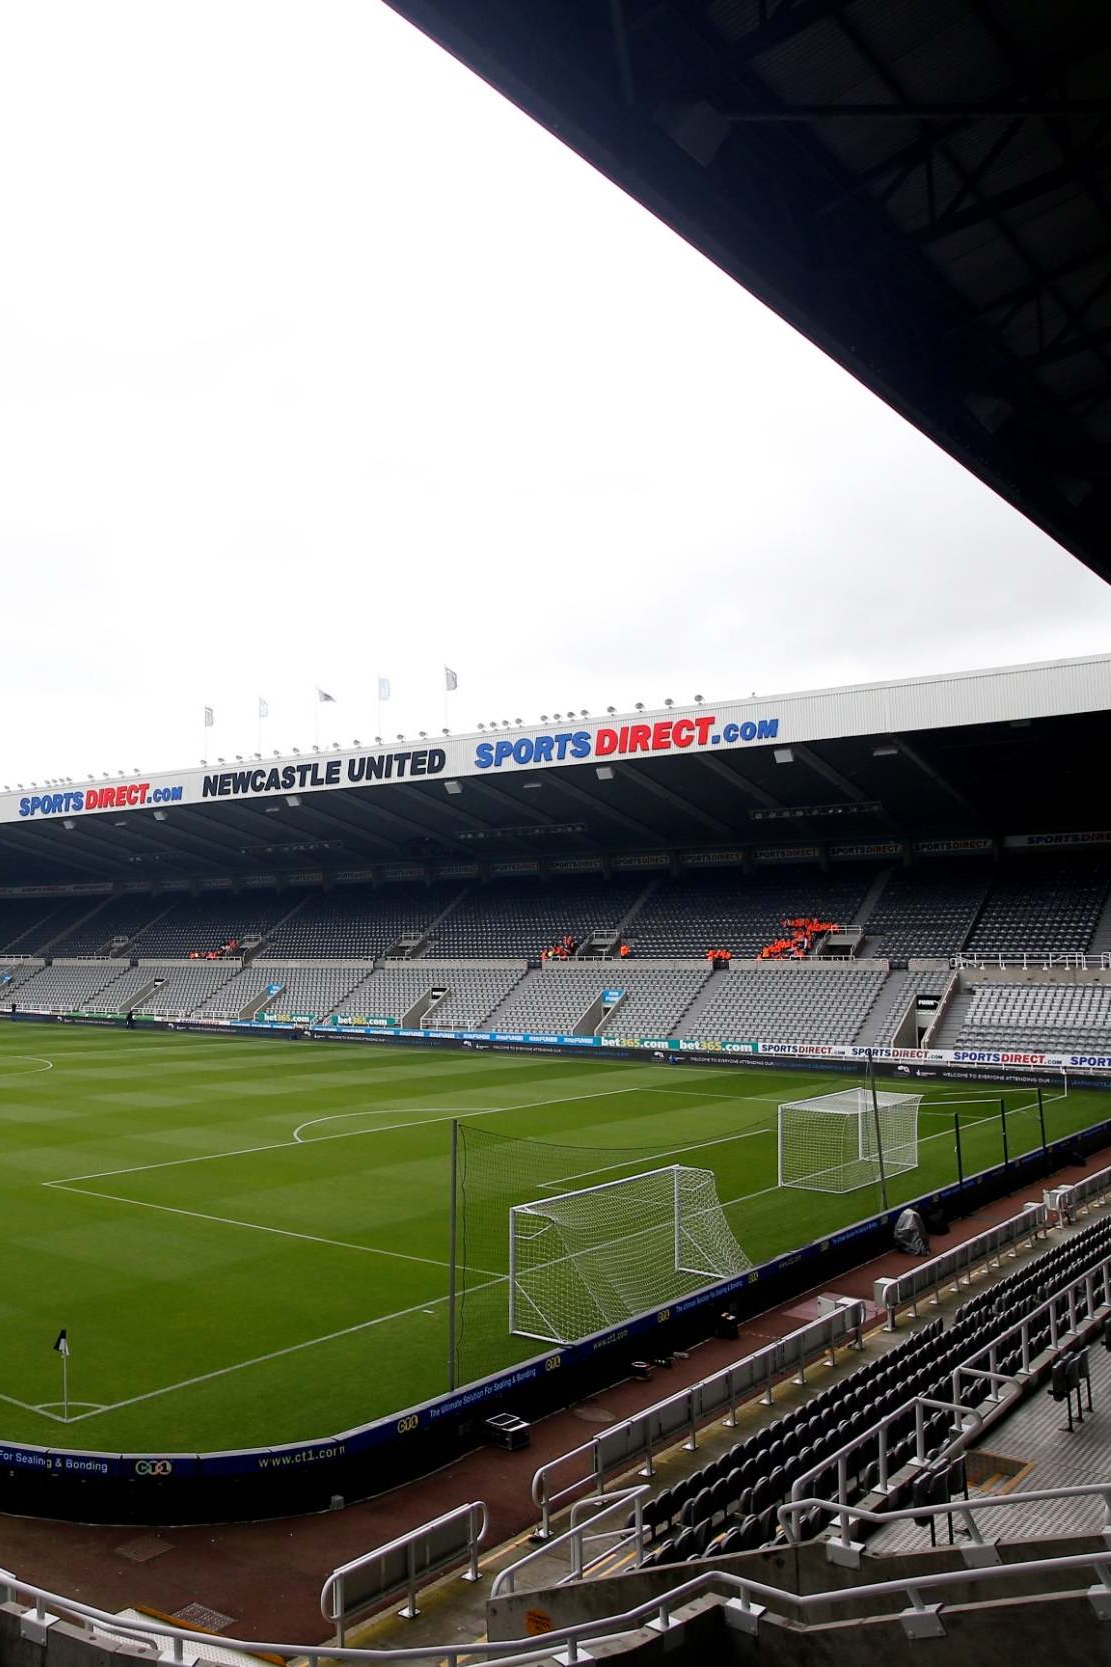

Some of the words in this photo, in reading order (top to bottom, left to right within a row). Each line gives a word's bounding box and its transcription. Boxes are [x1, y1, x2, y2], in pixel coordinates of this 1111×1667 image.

[201, 760, 342, 798] NEWCASTLE
[347, 748, 447, 787] UNITED
[601, 1036, 669, 1049] bet365.com
[680, 1038, 752, 1053] bet365.com
[16, 1453, 52, 1469] Sealing
[55, 1458, 62, 1468] &
[65, 1458, 108, 1473] Bonding
[258, 1445, 345, 1468] www.ct1.com
[135, 1459, 172, 1475] CT1
